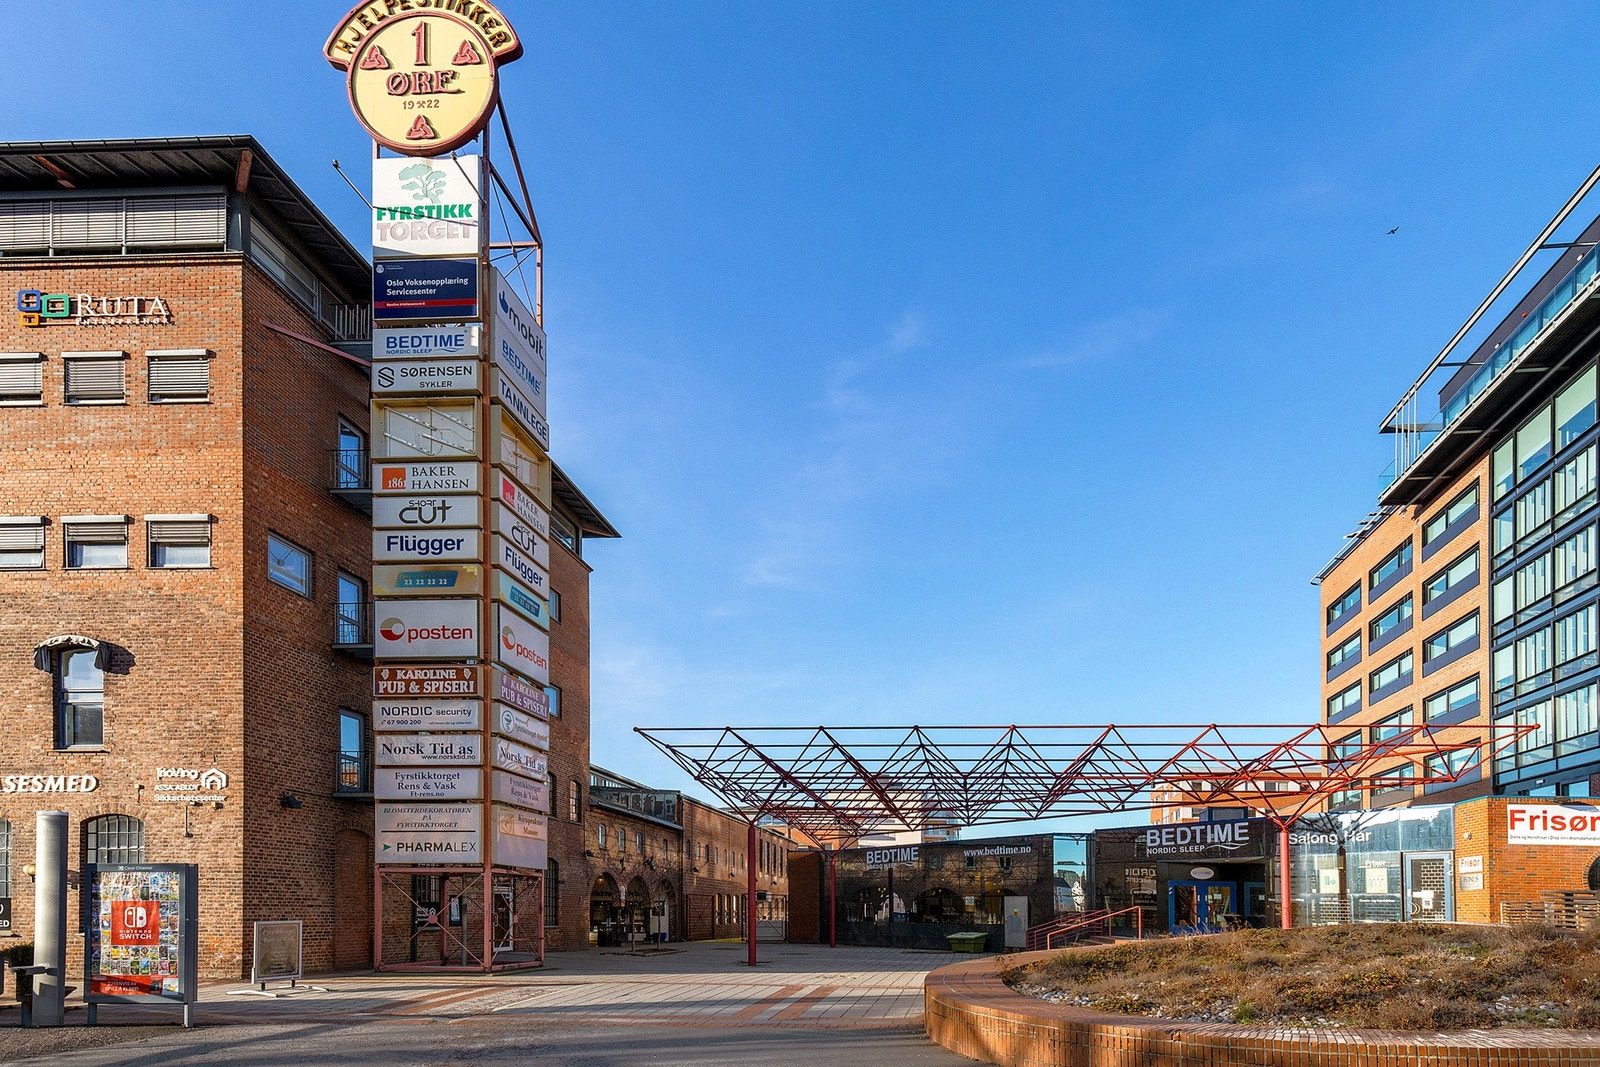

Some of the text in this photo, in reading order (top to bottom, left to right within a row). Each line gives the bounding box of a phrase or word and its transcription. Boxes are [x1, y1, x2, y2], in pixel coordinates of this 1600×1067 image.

[411, 21, 426, 66] 1
[386, 70, 463, 96] ØRE
[402, 99, 440, 110] 19 22
[376, 204, 473, 221] FYRSTIKK
[376, 220, 474, 242] TORGET
[386, 277, 469, 287] Oslo Voksenopplæring
[386, 288, 437, 296] Servicesenter
[76, 293, 167, 316] RUTA
[386, 334, 465, 349] BEDTIME
[508, 308, 544, 361] mobit
[400, 365, 472, 377] SØRENSEN
[502, 339, 541, 391] BEDTIME
[419, 380, 452, 388] SYKLER
[500, 378, 548, 442] TANNLEGE
[412, 466, 456, 477] BAKER
[411, 479, 470, 490] HANSEN
[517, 491, 539, 516] BAKER
[517, 503, 546, 534] HANSEN
[386, 535, 465, 556] Flügger
[505, 546, 543, 587] Flügger
[407, 625, 473, 643] posten
[516, 643, 547, 670] posten
[396, 669, 457, 679] KAROLINE
[378, 680, 475, 694] PUB & SPISERI
[511, 679, 539, 700] KAROLINE
[501, 686, 516, 702] PUB
[523, 696, 547, 717] SPISERI
[381, 706, 472, 717] NORDIC security
[382, 743, 473, 755] Norsk Tid as
[500, 746, 523, 765] Norsk
[524, 755, 536, 768] Tid
[537, 762, 545, 772] as
[0, 775, 97, 793] SESMED
[395, 771, 460, 782] Fyrstikktorget
[397, 782, 456, 790] Rens & Vask
[1509, 809, 1600, 832] Frisør
[1146, 822, 1250, 847] BEDTIME
[1288, 832, 1338, 845] Salong
[397, 842, 477, 852] PHARMALEX
[866, 847, 919, 864] BEDTIME
[963, 845, 1032, 857] www.bedtime.no
[1146, 845, 1206, 855] NORDIC SLEEP
